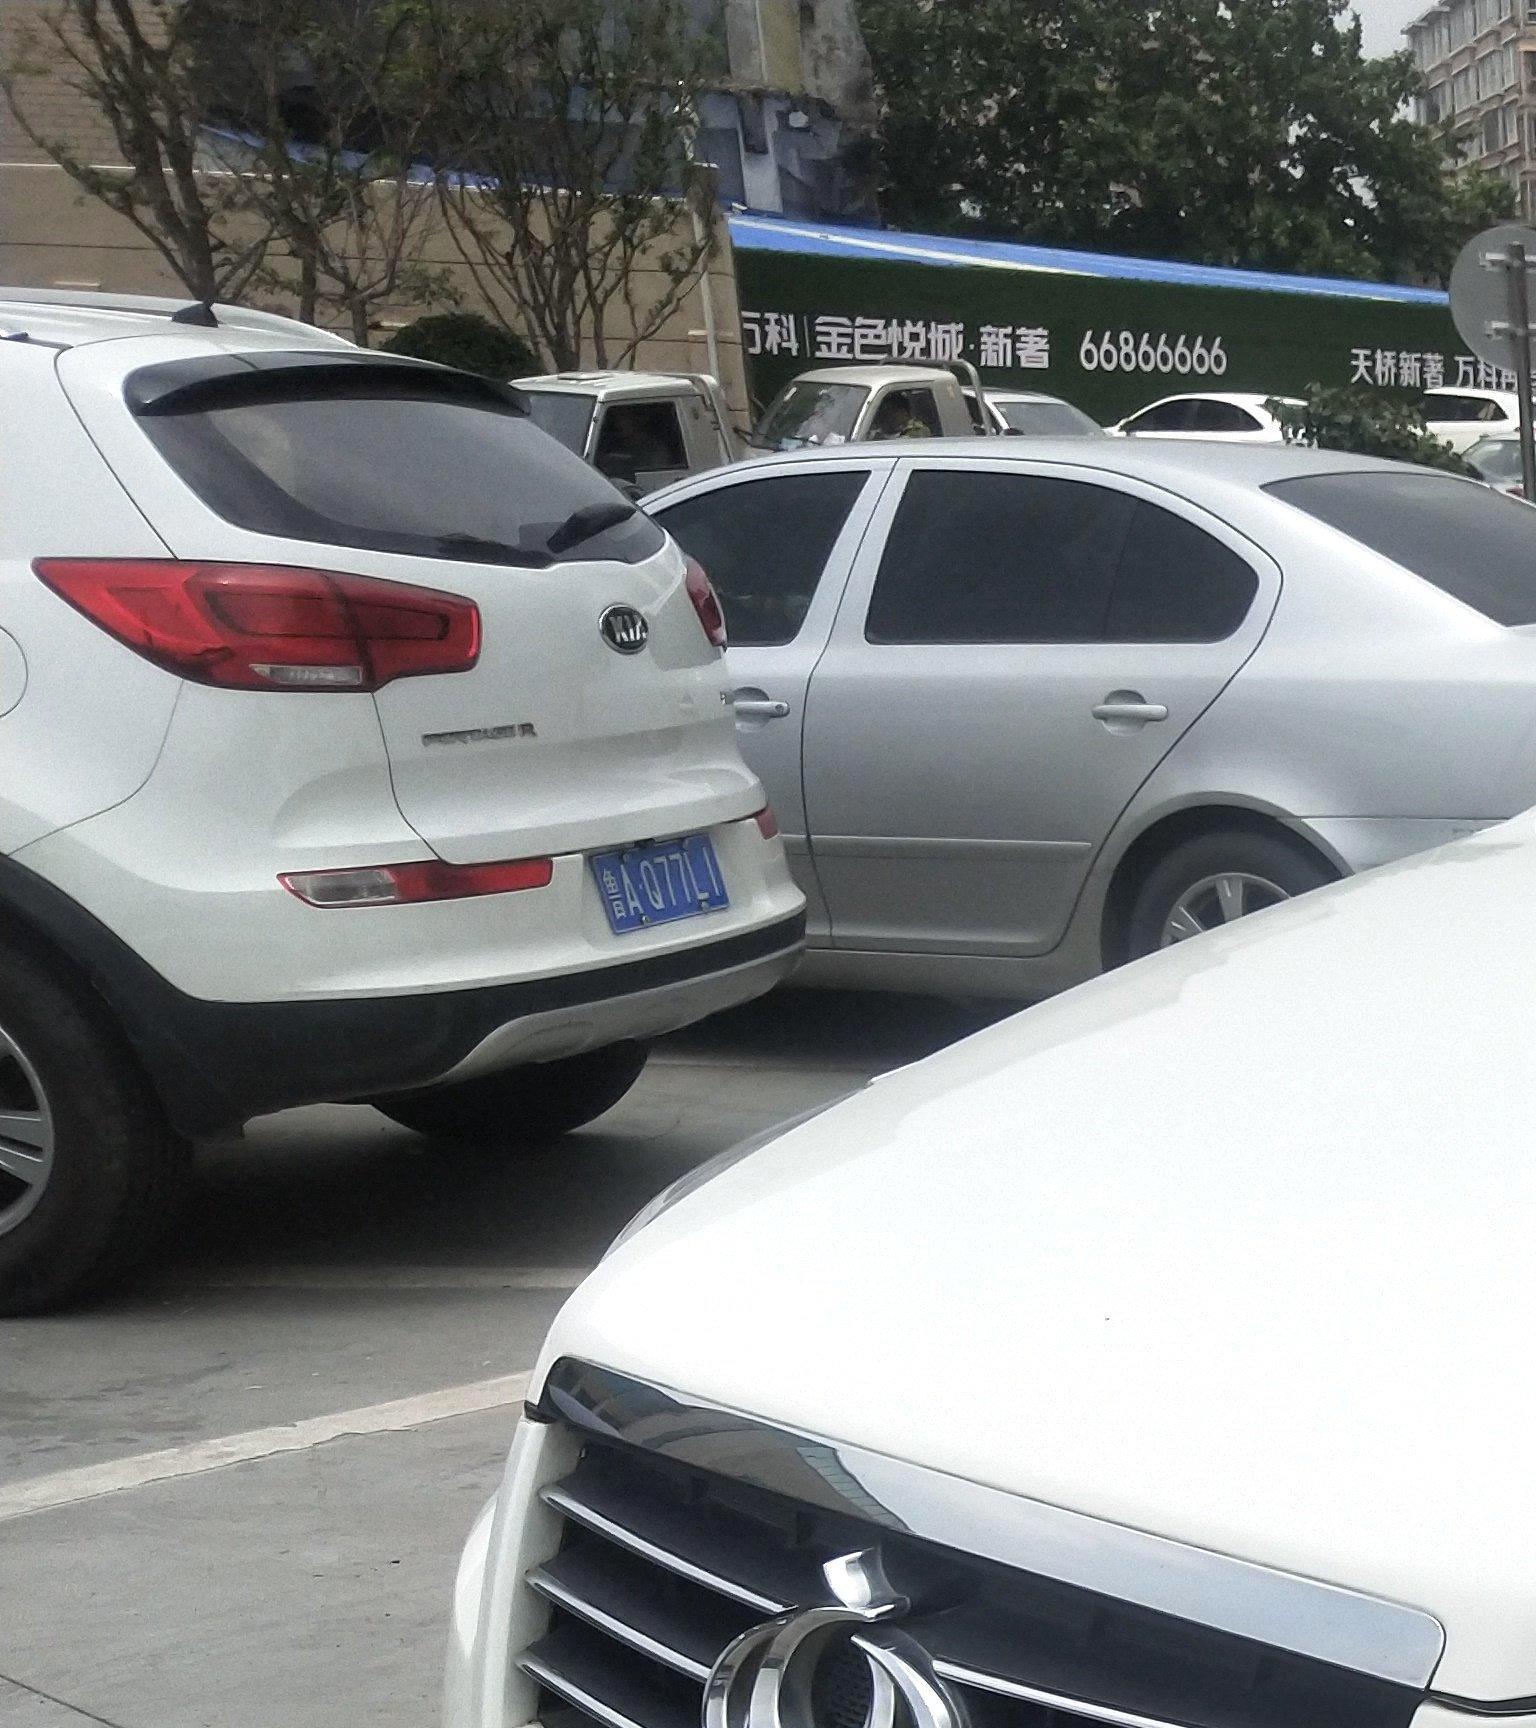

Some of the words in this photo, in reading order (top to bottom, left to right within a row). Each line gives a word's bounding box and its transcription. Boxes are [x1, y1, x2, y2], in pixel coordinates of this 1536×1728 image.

[1080, 329, 1228, 375] 66866666
[1350, 348, 1445, 389] 天桥新著
[608, 614, 647, 643] KIA
